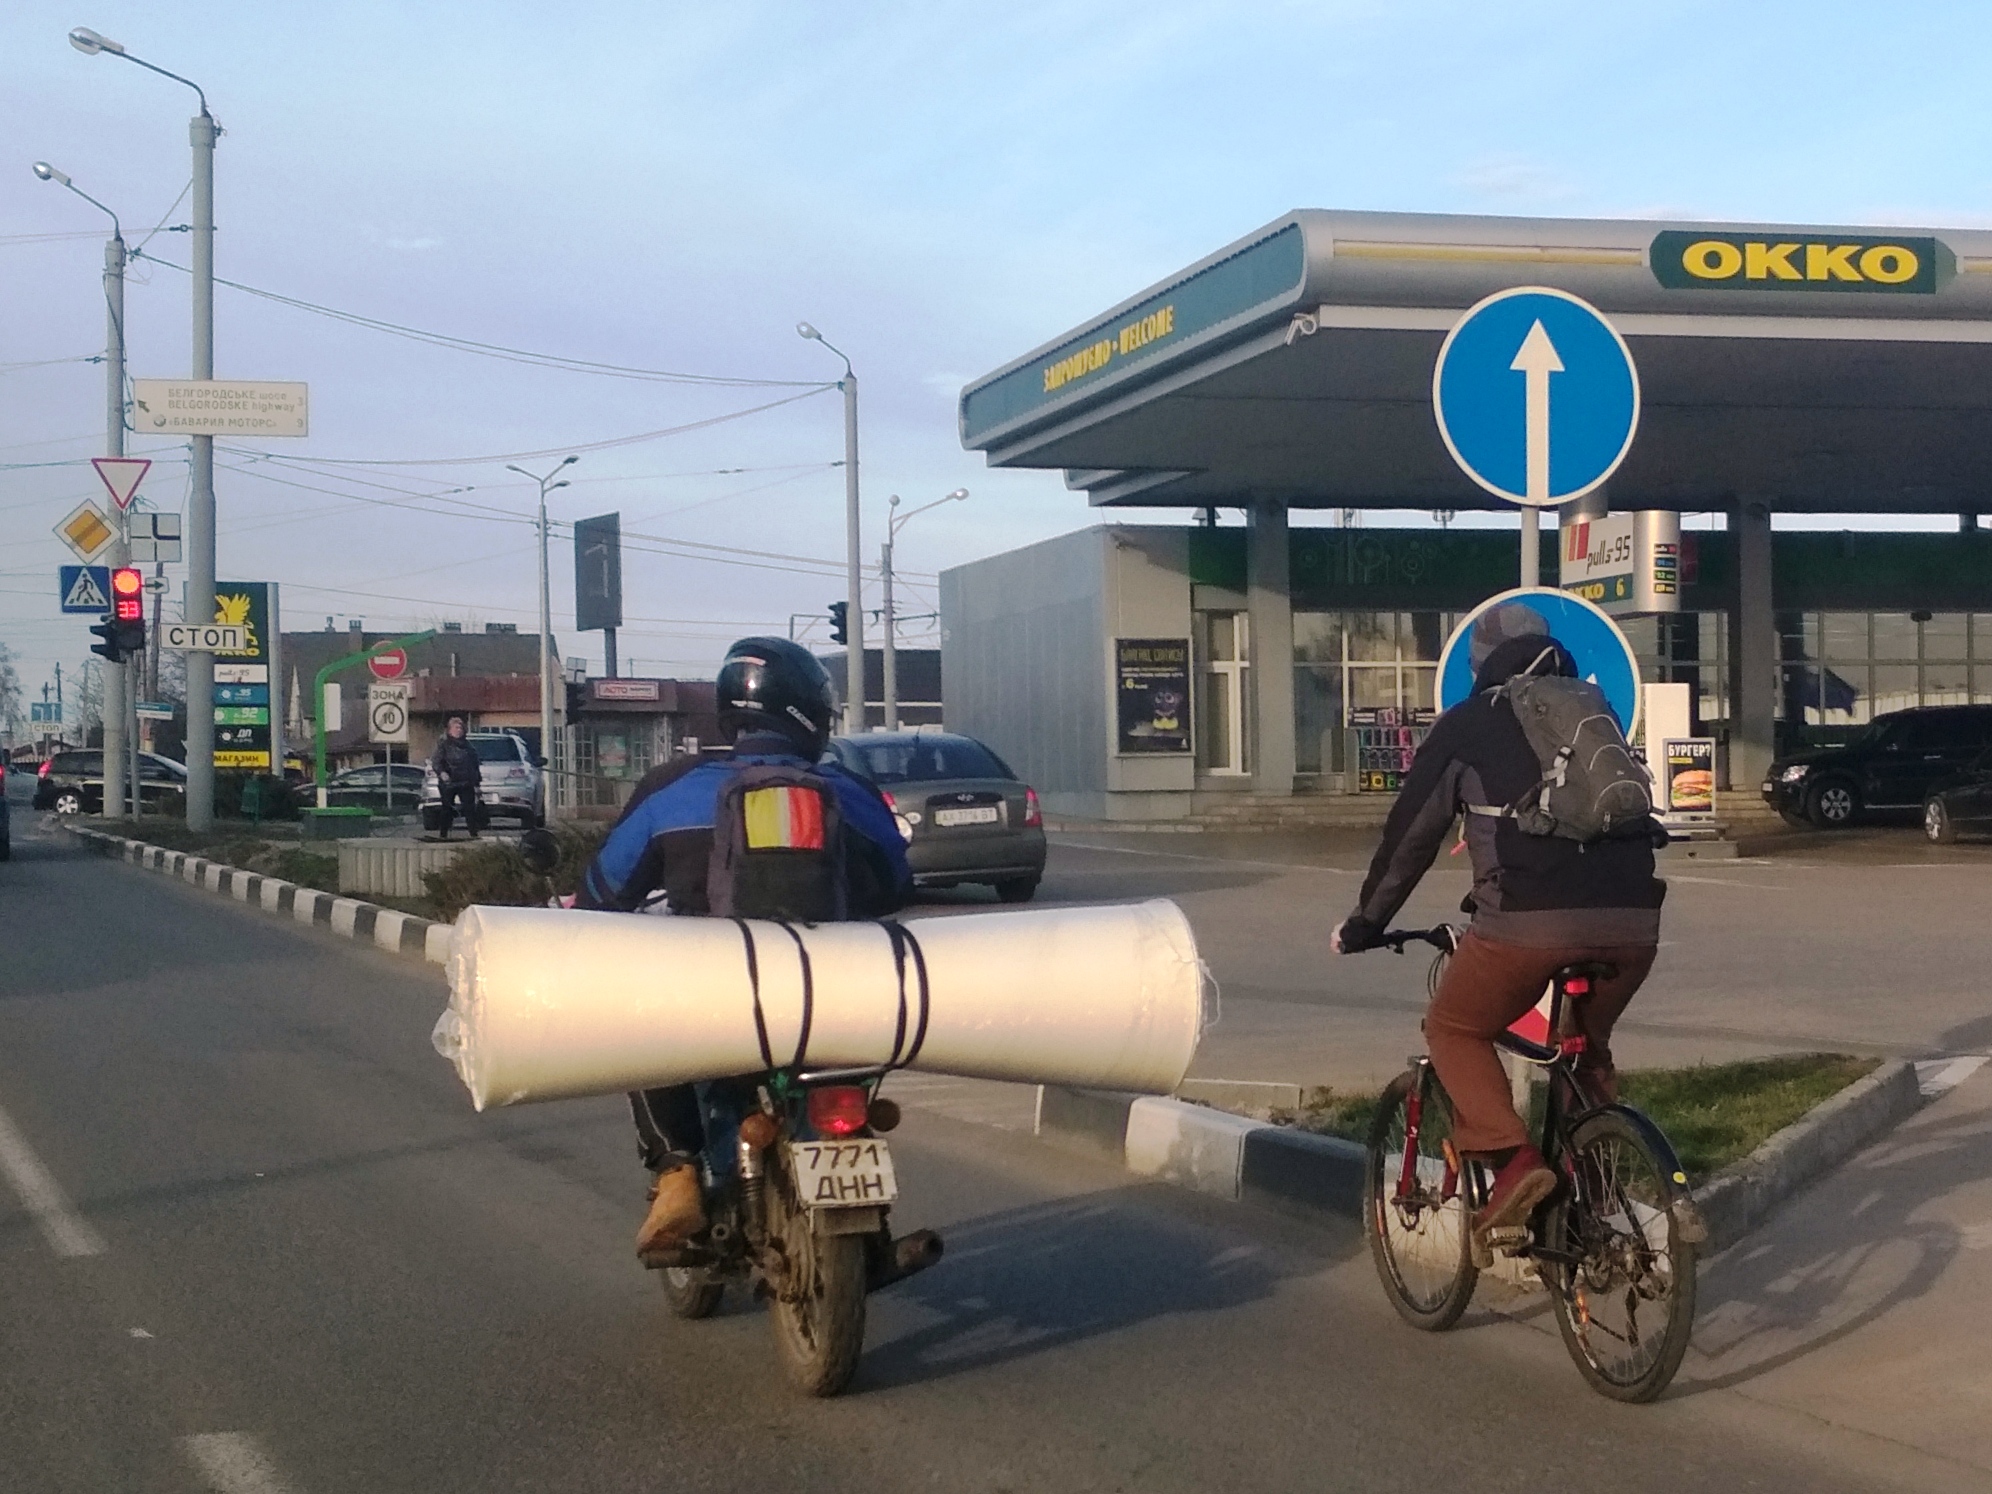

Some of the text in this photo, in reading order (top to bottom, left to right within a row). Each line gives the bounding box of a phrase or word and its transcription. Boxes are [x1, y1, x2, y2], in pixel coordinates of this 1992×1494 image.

[1681, 240, 1919, 284] OKKO
[1119, 305, 1174, 355] WELCOME
[259, 391, 287, 400] шосе
[168, 400, 295, 413] BELGORODSKE highway
[1615, 578, 1625, 597] 6
[118, 601, 140, 619] 33
[169, 627, 237, 647] СТОП
[372, 690, 404, 700] ЗОНА
[383, 712, 395, 724] 10
[1668, 744, 1711, 757] БУРГЕР?
[803, 1144, 879, 1169] 7771
[815, 1173, 884, 1200] ДНН
